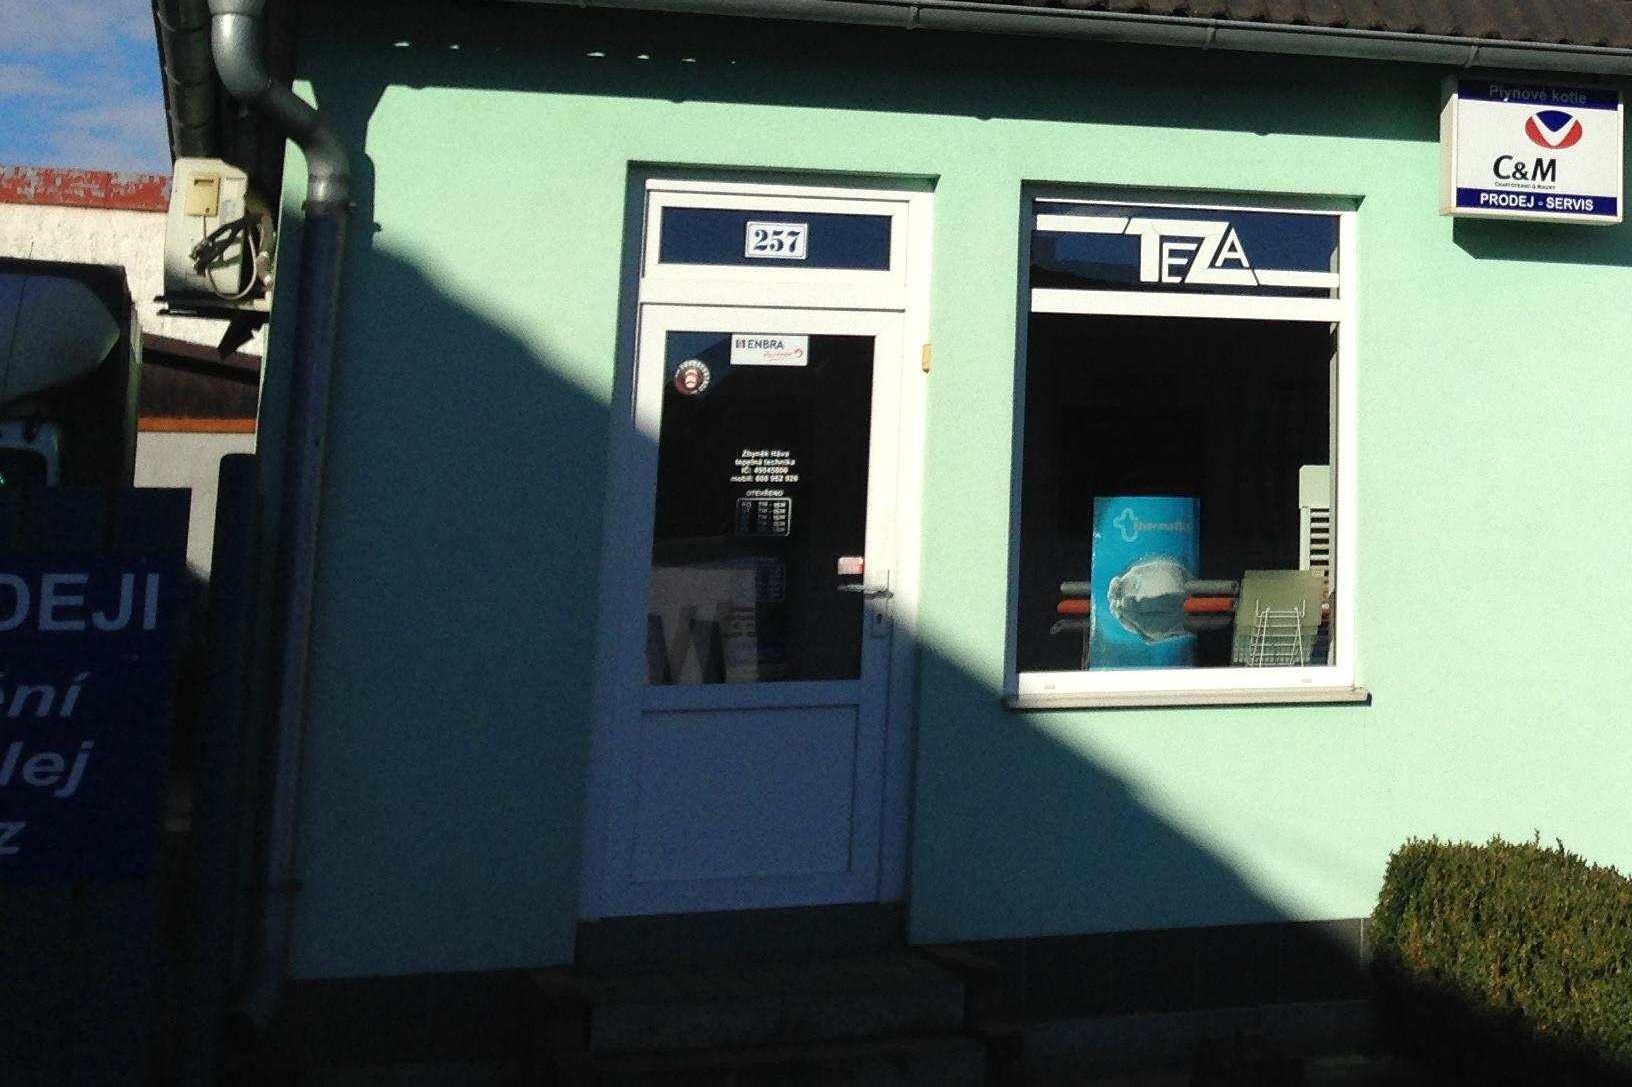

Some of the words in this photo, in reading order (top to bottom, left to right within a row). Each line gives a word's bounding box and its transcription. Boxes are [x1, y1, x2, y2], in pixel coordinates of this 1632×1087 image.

[1489, 84, 1547, 102] Plynové
[1552, 89, 1587, 104] kotle
[1493, 154, 1557, 183] C&M
[1480, 193, 1535, 207] PRODEJ
[1546, 197, 1594, 211] SERVIS
[753, 229, 801, 253] 257
[1124, 217, 1259, 286] TEZA
[747, 339, 784, 350] ENBRA
